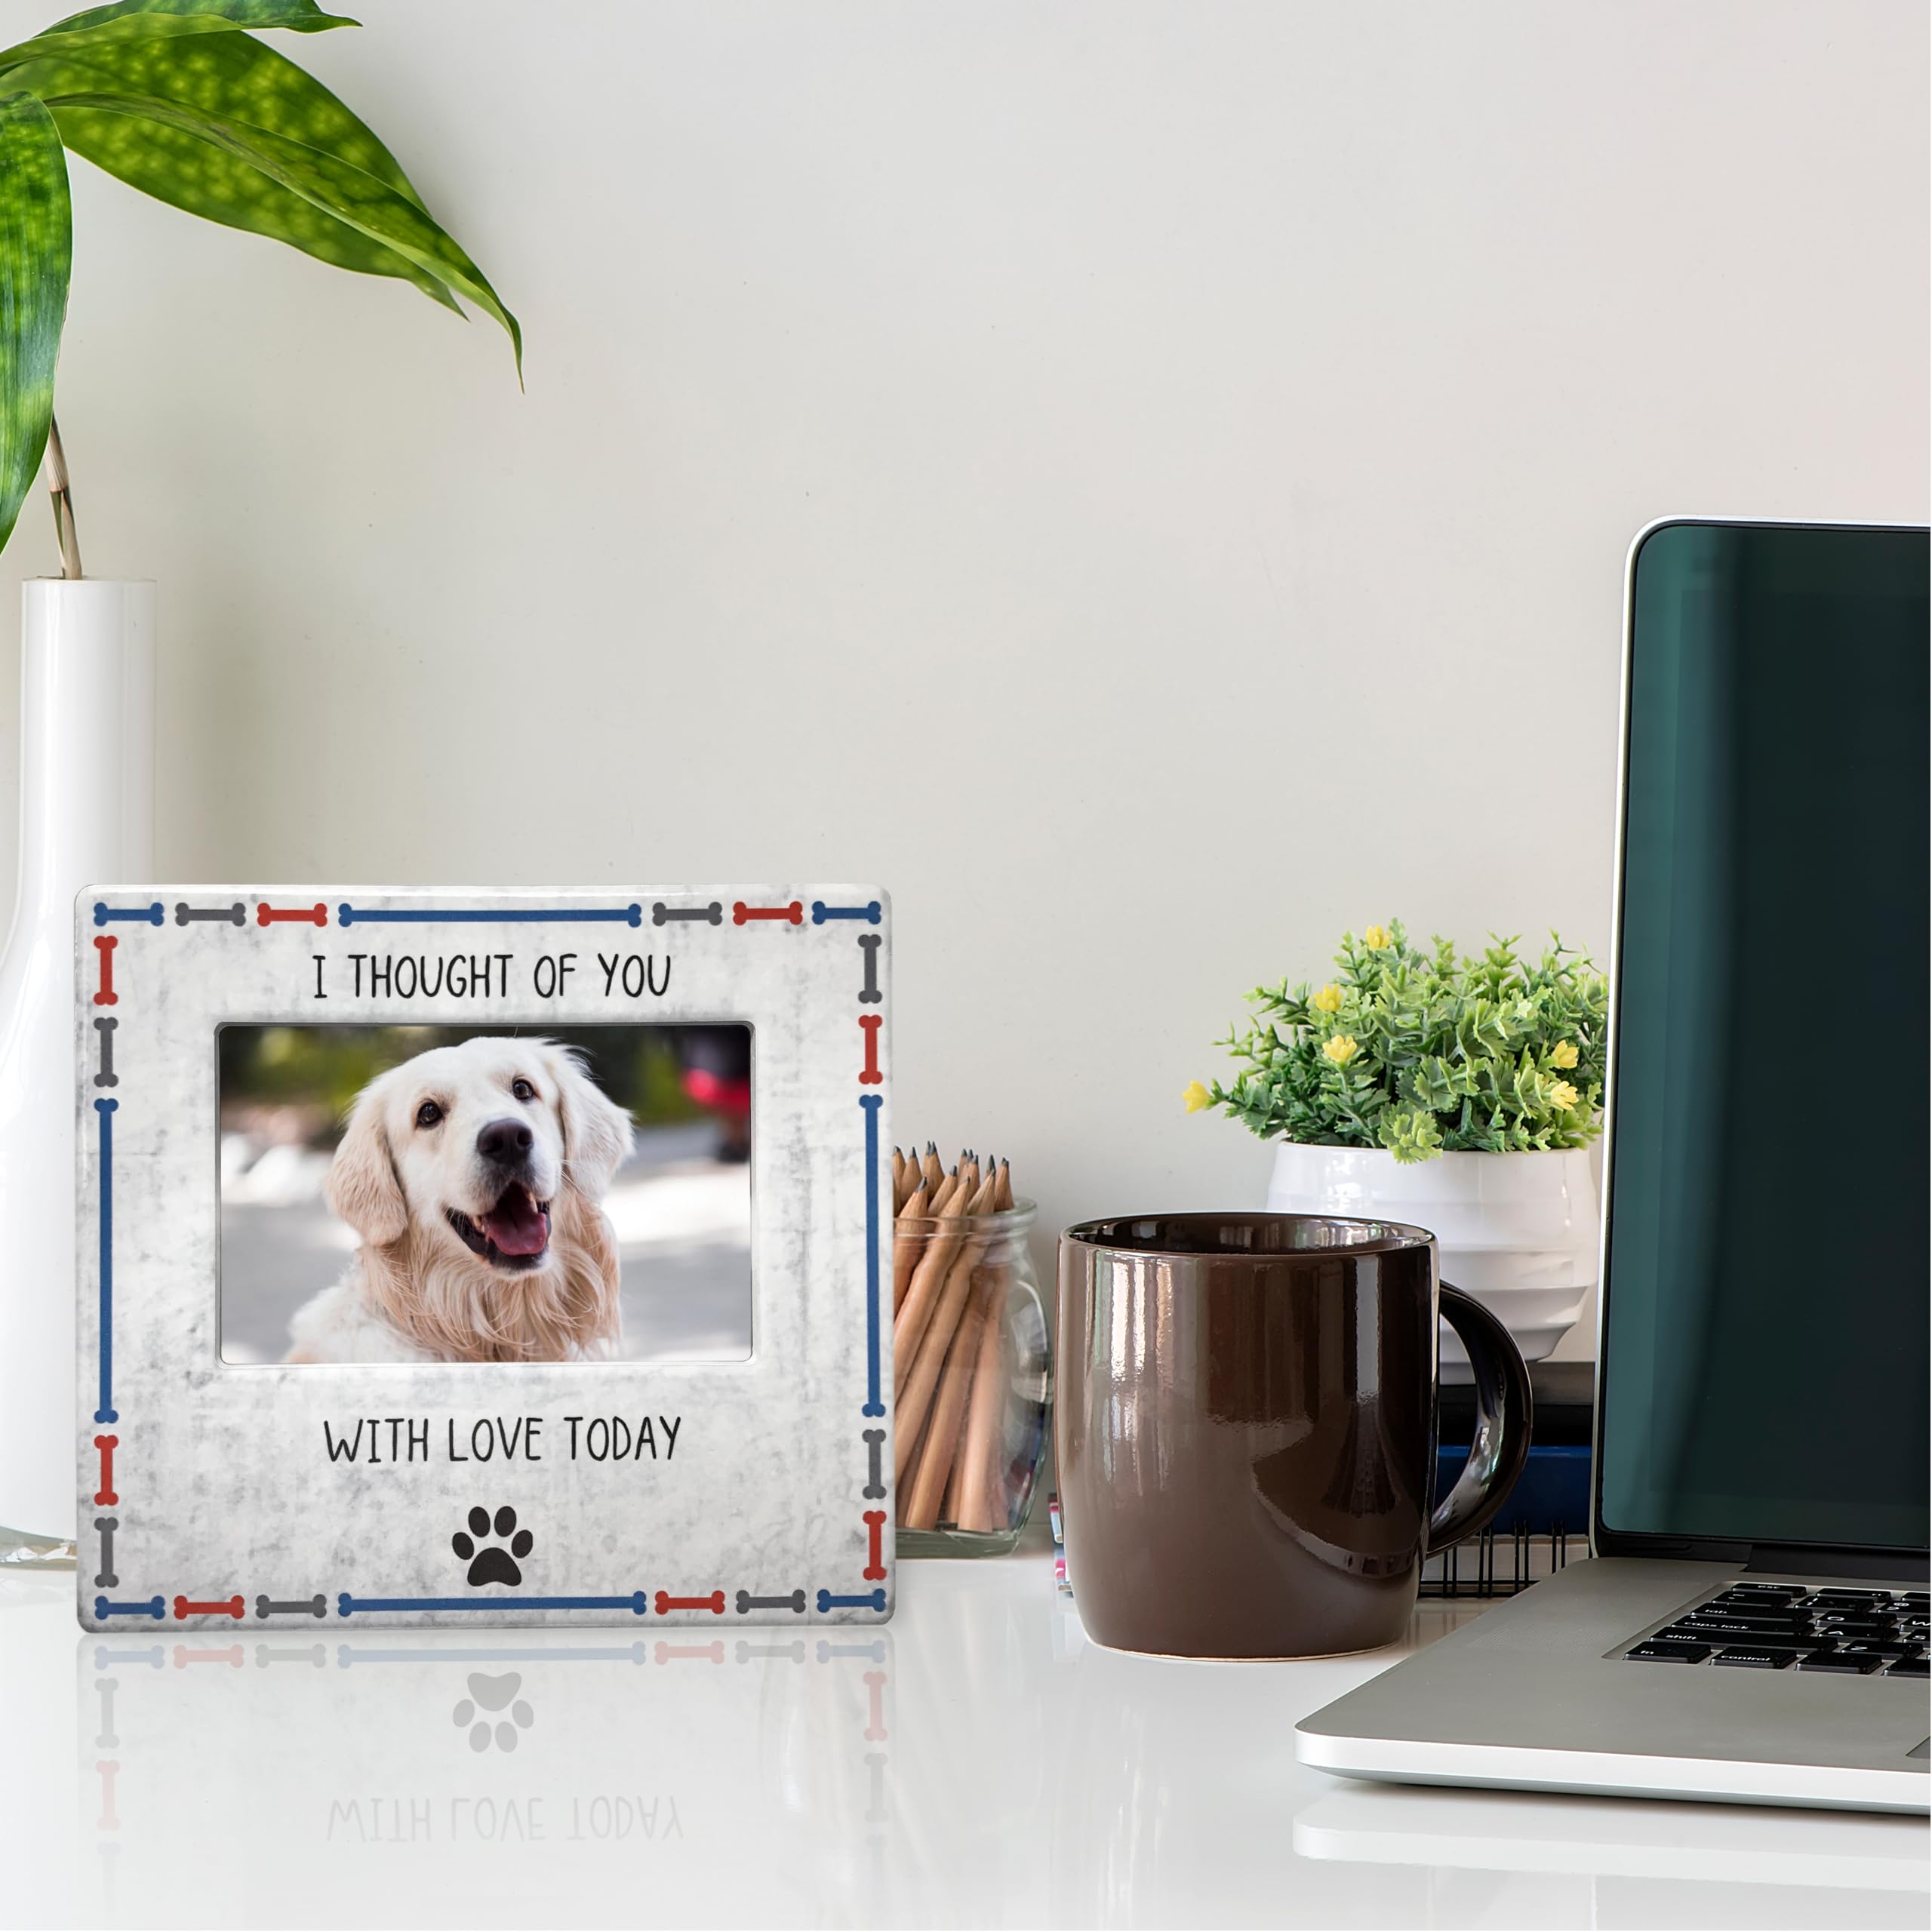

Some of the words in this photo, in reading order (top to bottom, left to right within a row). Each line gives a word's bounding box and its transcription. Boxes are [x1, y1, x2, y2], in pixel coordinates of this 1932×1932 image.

[312, 955, 328, 998] I
[347, 954, 514, 999] THOUGHT
[534, 953, 578, 998] OF
[597, 952, 672, 998] YOU
[324, 1418, 429, 1463] WITH
[448, 1417, 543, 1463] LOVE
[563, 1416, 681, 1462] TODAY
